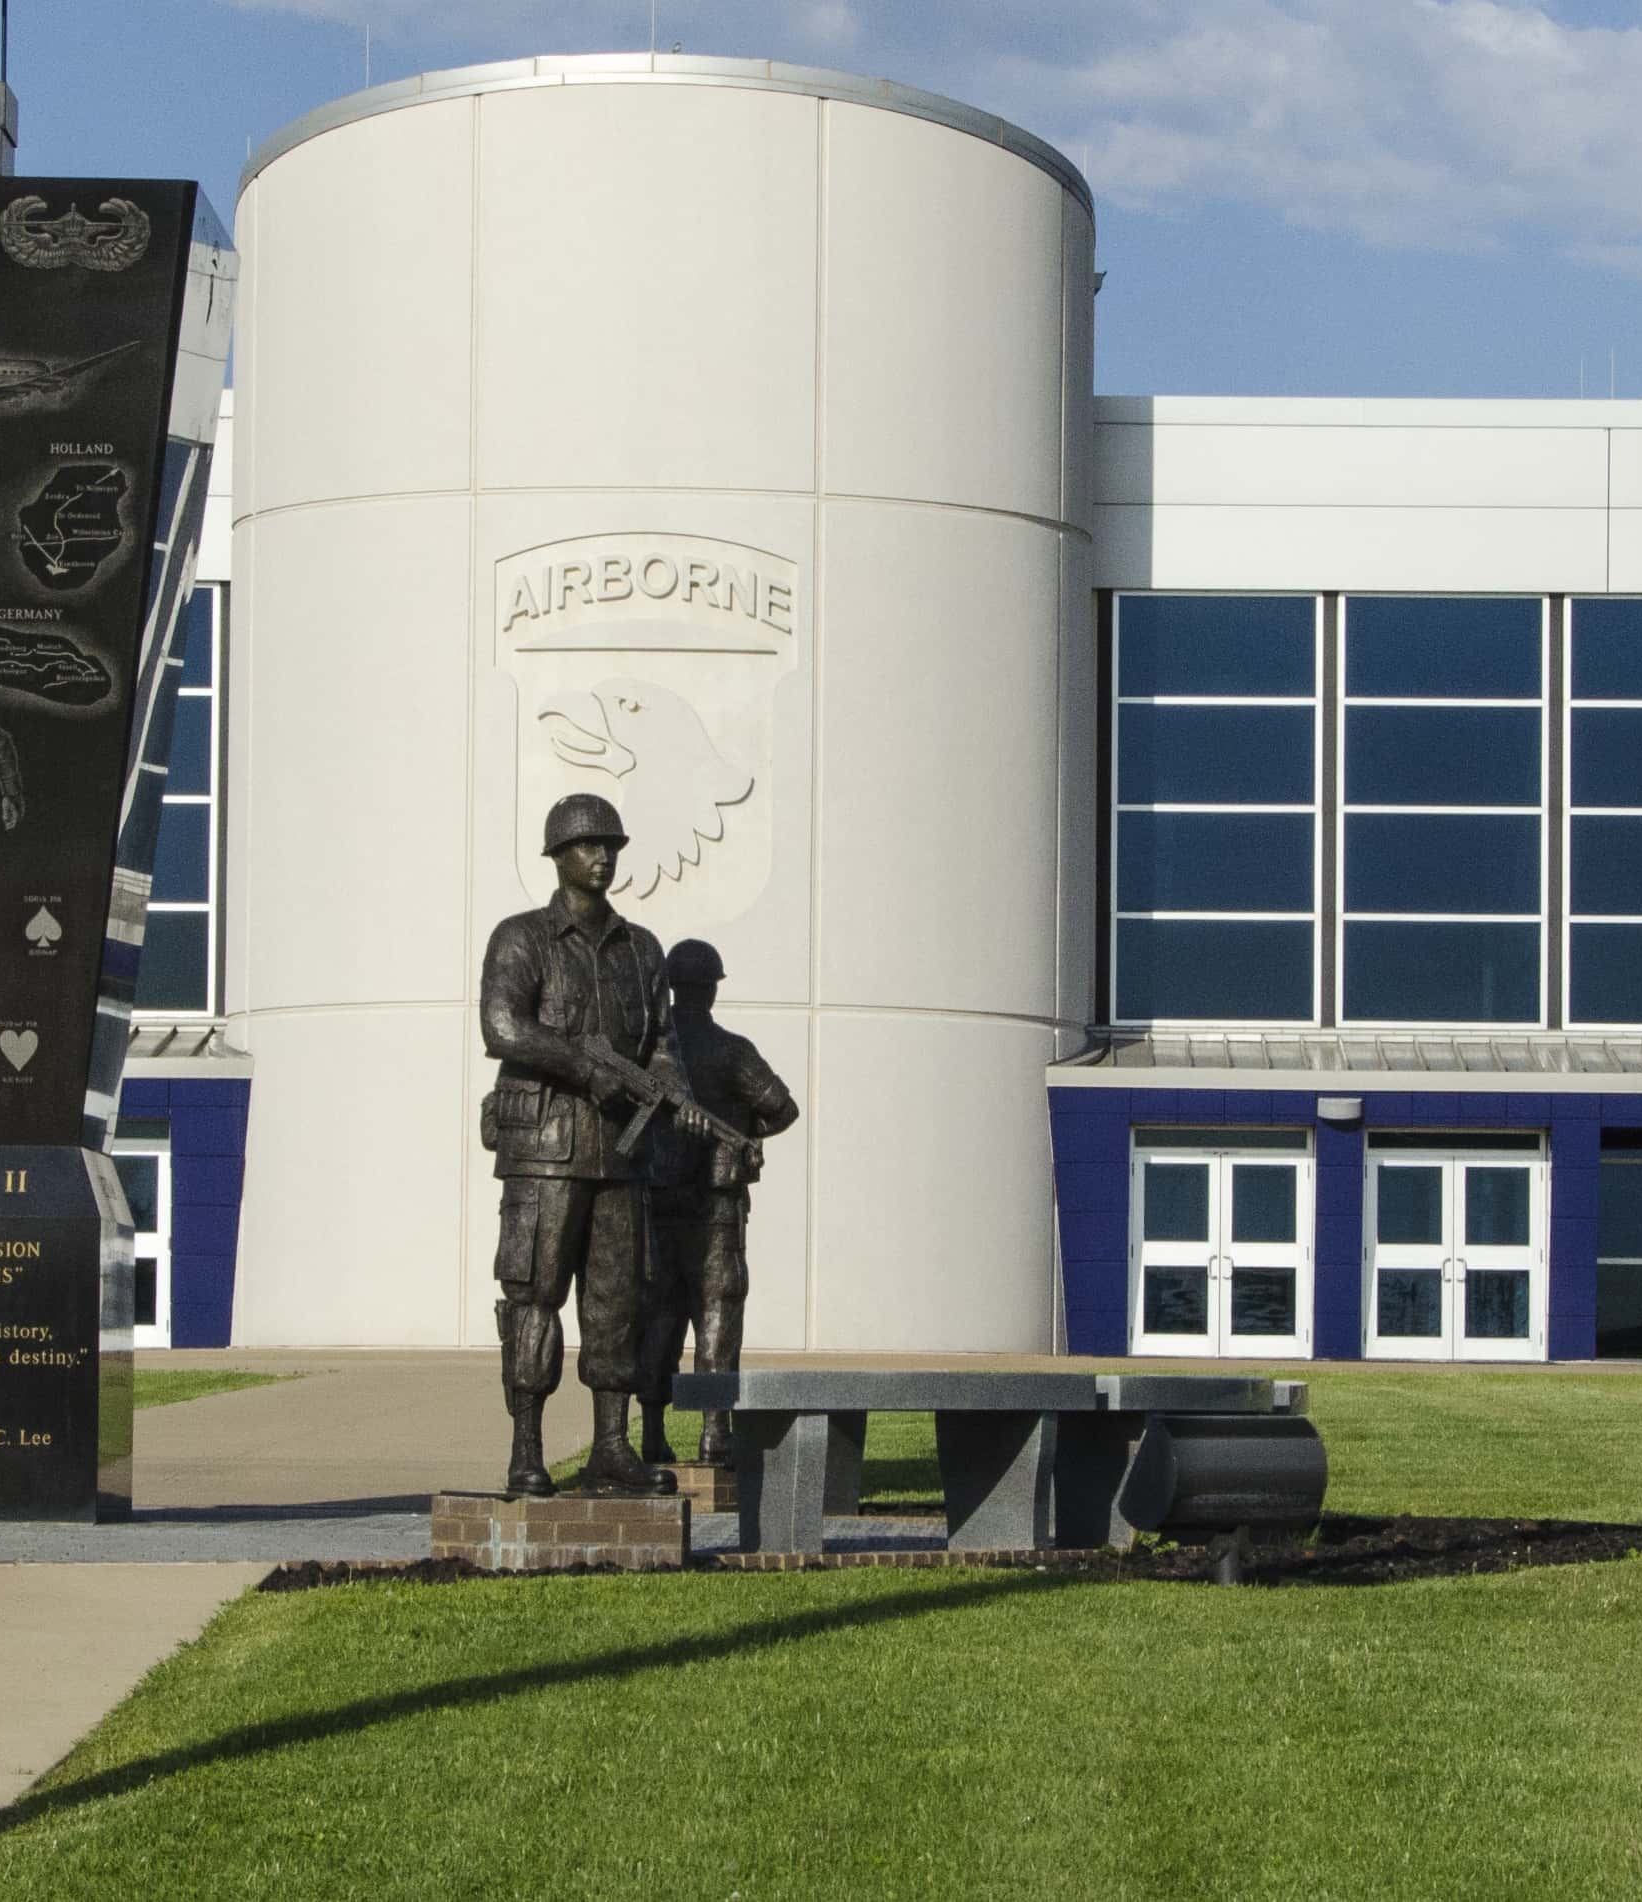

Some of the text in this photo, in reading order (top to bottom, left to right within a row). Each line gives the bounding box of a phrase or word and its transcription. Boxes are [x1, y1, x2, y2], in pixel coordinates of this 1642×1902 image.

[49, 443, 114, 455] HOLLAND
[503, 552, 793, 636] AIRBORNE
[5, 1170, 27, 1193] II
[9, 1348, 88, 1368] destiny."
[20, 1430, 52, 1446] Lee
